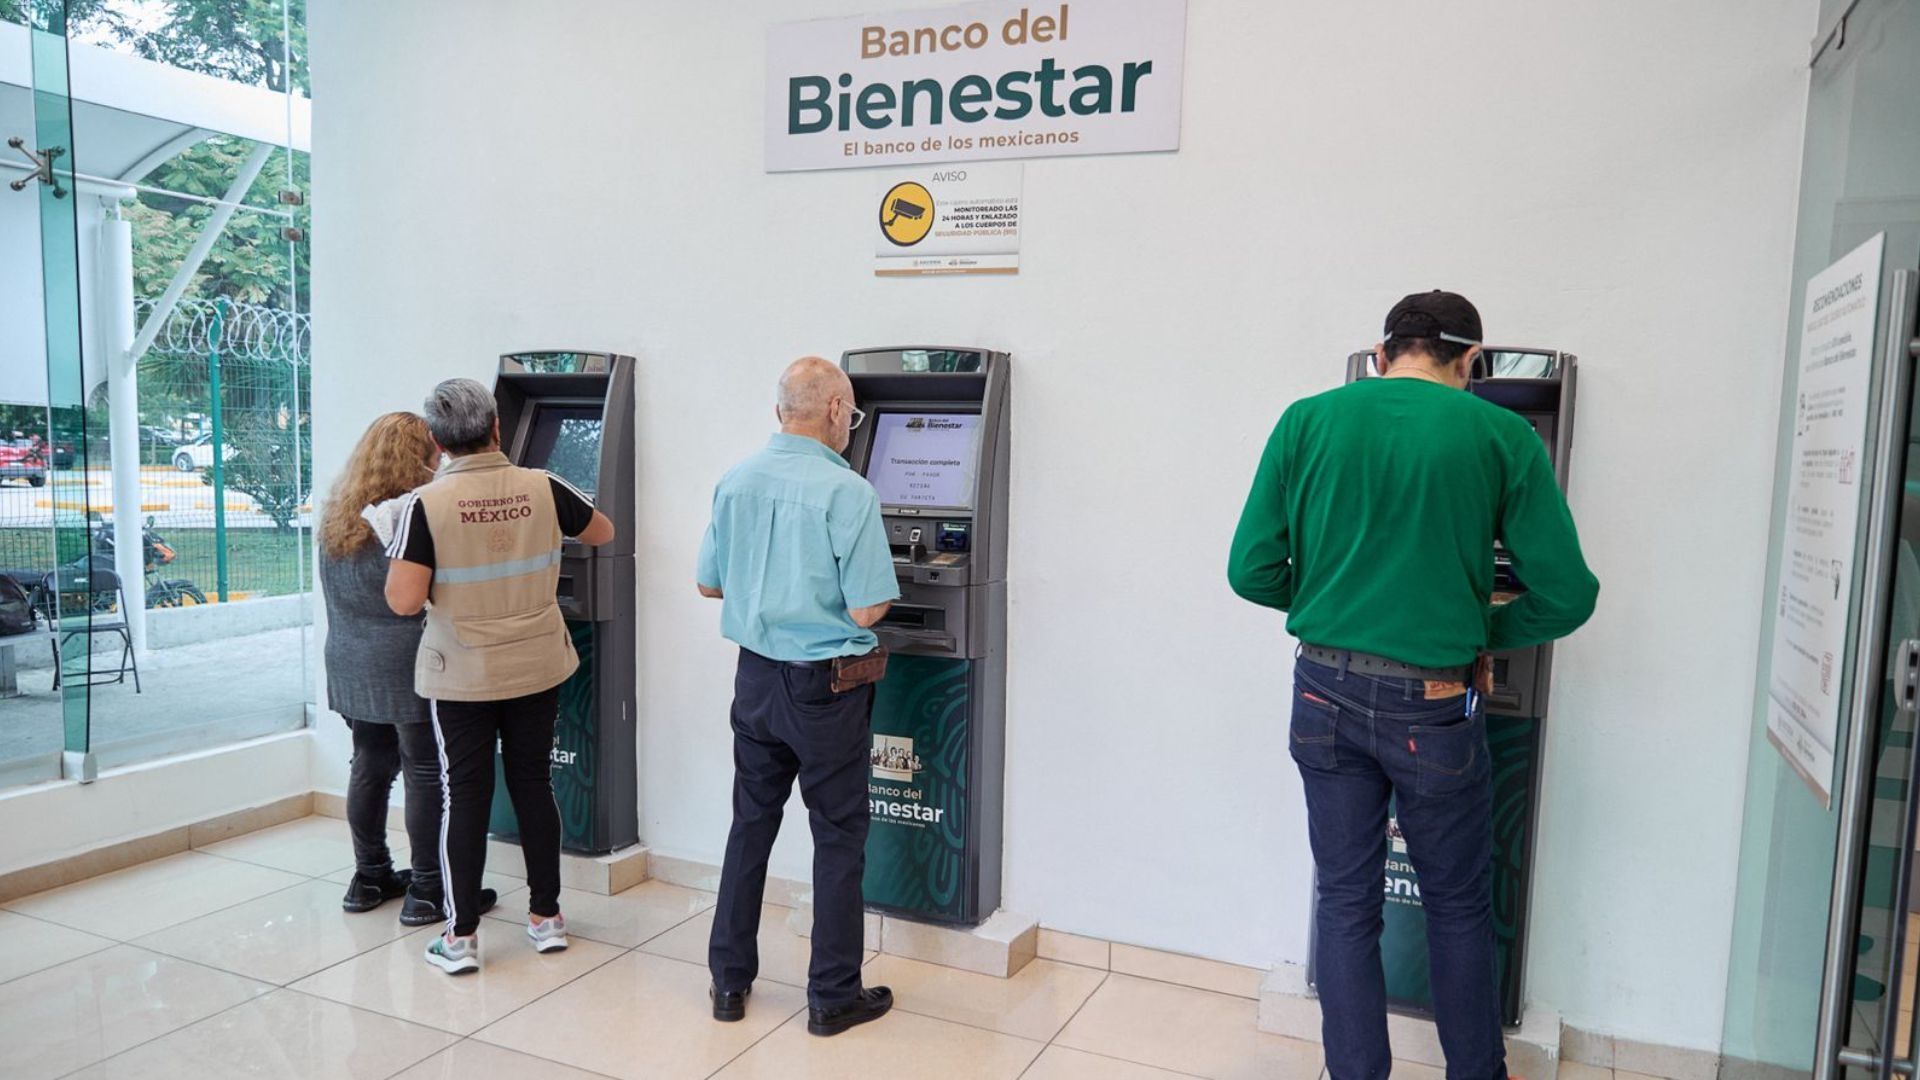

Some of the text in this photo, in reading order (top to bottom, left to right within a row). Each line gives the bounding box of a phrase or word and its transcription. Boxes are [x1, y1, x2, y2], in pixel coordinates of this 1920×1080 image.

[861, 4, 1068, 59] Banco del
[787, 58, 1153, 135] Bienestar
[843, 129, 1079, 157] El banco de los mexicanos
[932, 170, 967, 182] AVISO
[954, 205, 1004, 213] MONITOREADO
[458, 494, 530, 508] GOBIERNO DE
[460, 506, 532, 523] MÉXICO
[903, 788, 922, 800] del
